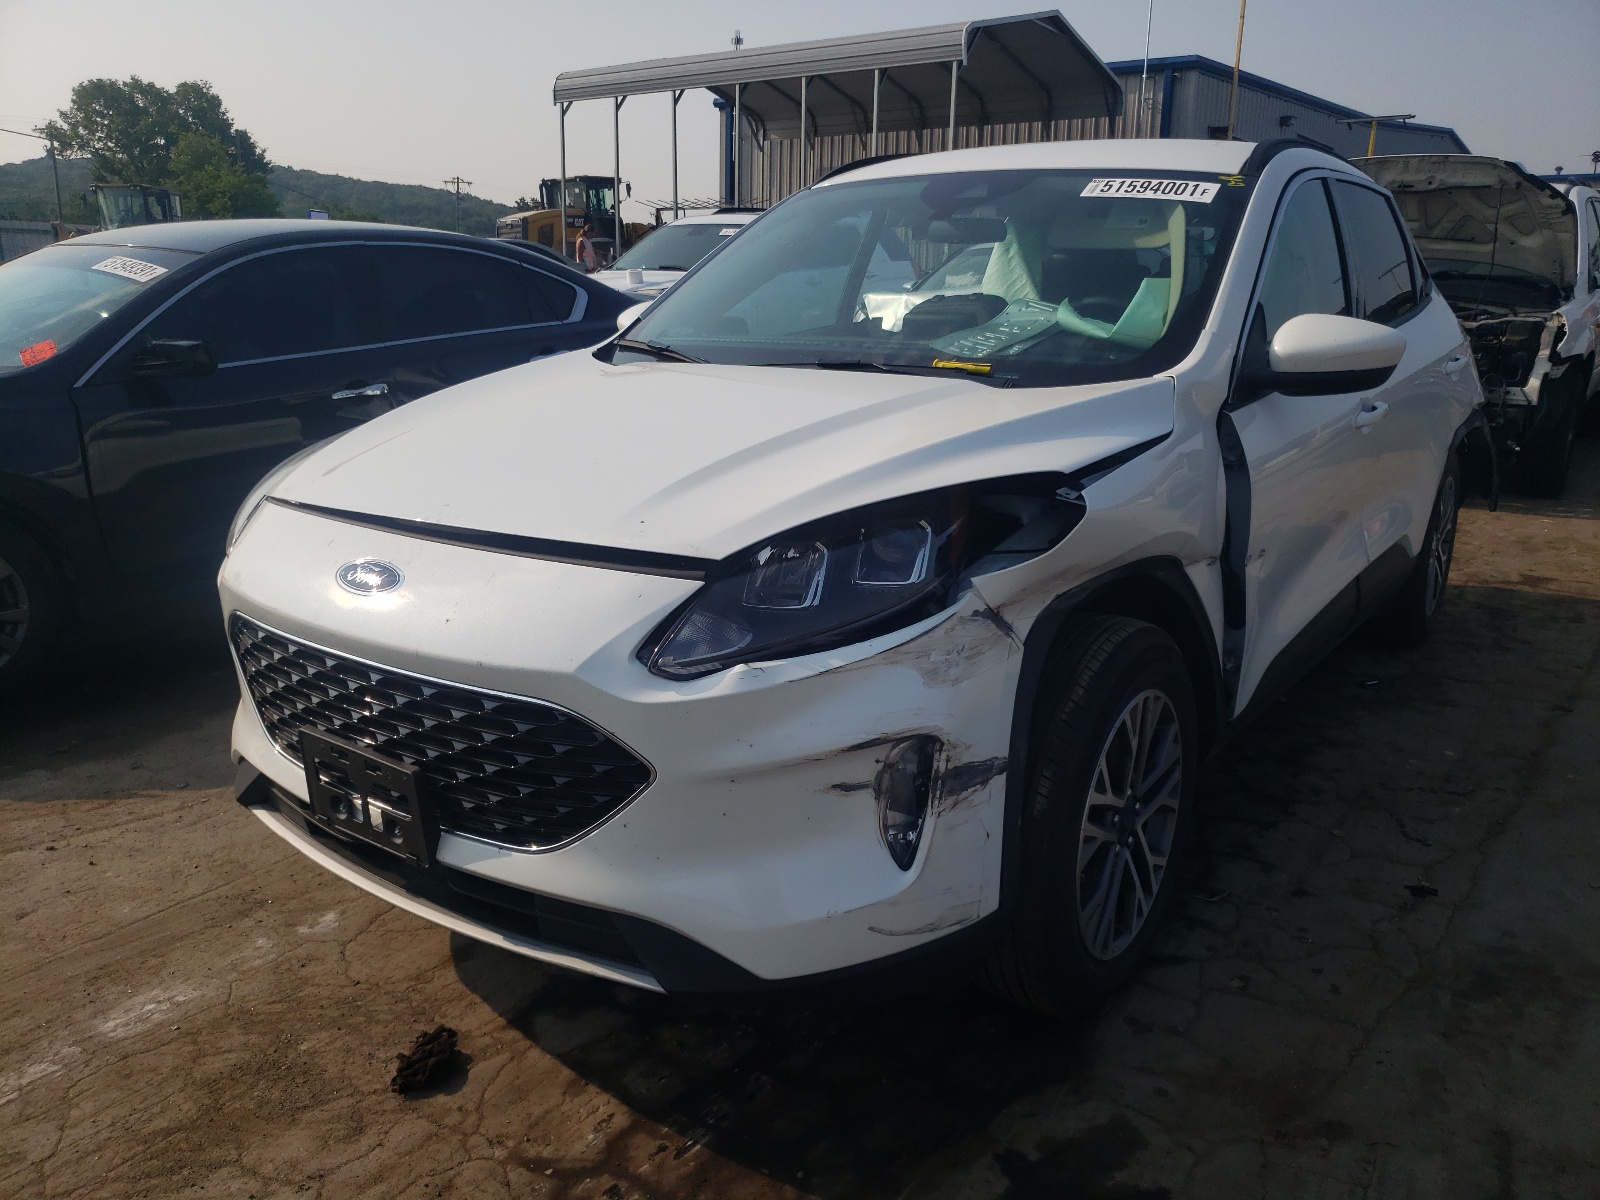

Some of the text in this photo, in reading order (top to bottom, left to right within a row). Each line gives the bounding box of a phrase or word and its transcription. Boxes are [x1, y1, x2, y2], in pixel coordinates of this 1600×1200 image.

[1099, 180, 1200, 197] 51594001
[1200, 188, 1211, 197] F
[574, 218, 585, 227] CAT
